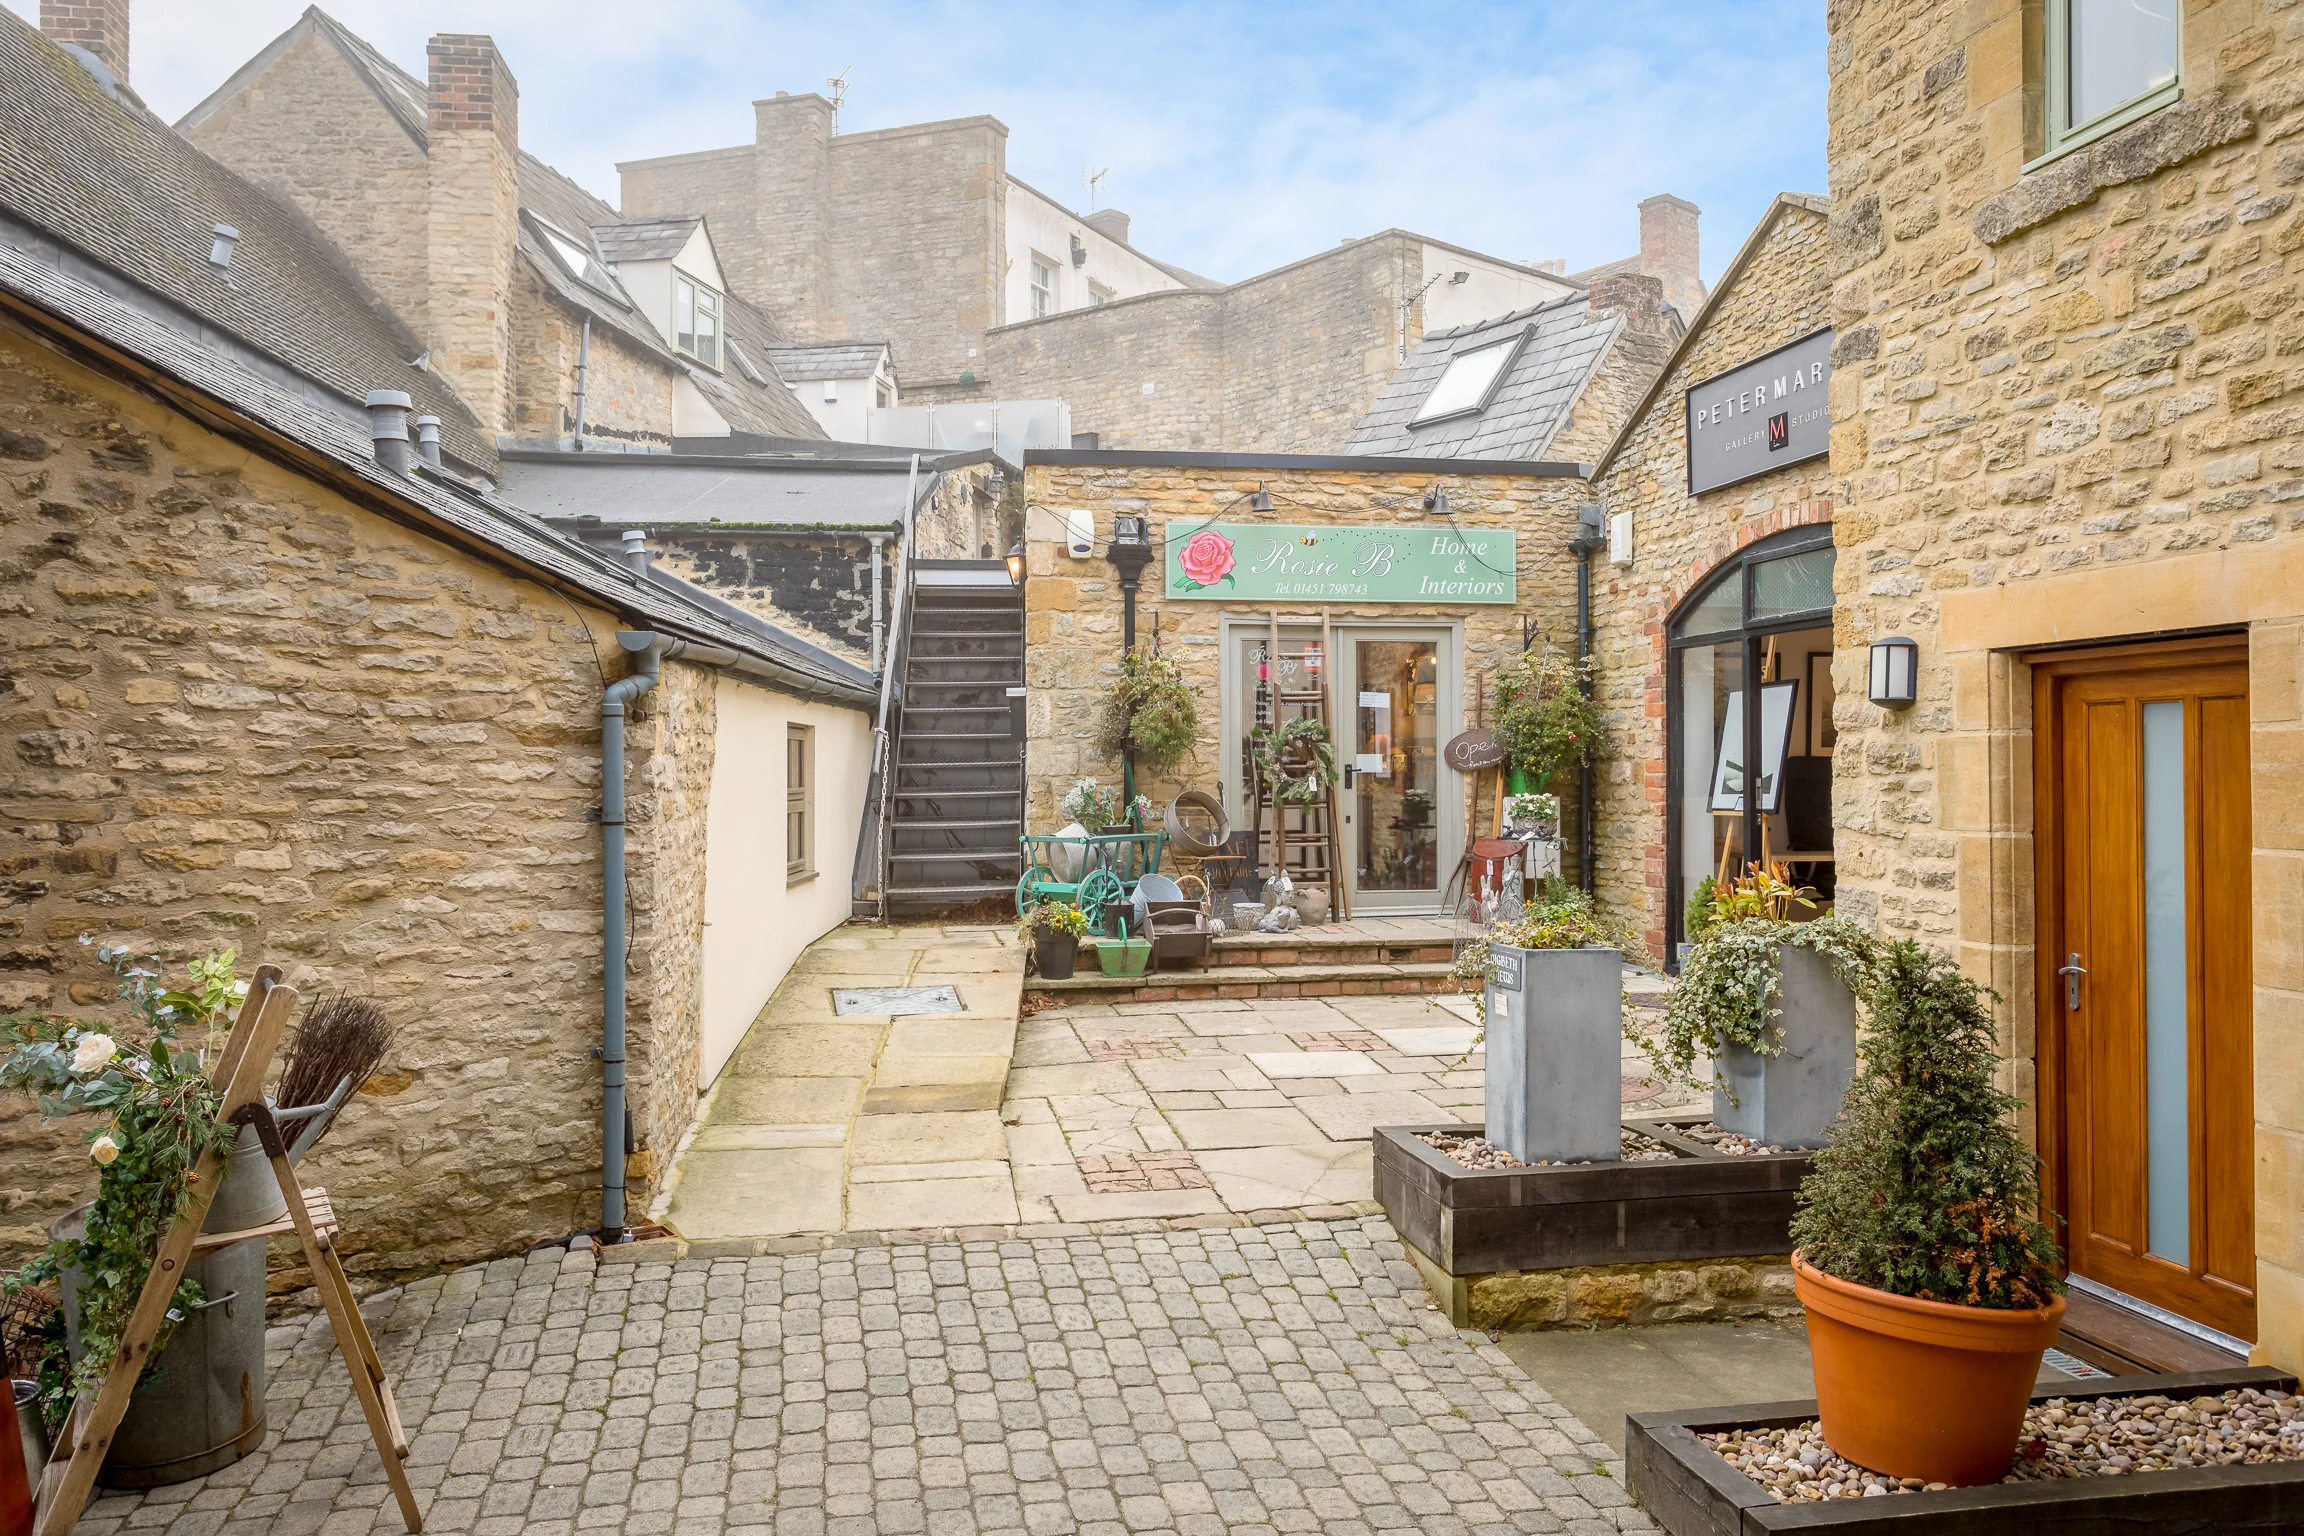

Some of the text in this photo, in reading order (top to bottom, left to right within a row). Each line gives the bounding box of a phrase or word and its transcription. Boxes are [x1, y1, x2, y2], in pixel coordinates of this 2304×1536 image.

[1698, 386, 1766, 429] PETER
[1725, 429, 1766, 452] GALLERY
[1769, 414, 1785, 442] M
[1429, 536, 1488, 556] Home
[1251, 538, 1396, 578] Rosie B
[1454, 559, 1468, 574] &
[1274, 582, 1368, 595] Tel. 01451 798743
[1418, 576, 1505, 595] Interiors
[1490, 953, 1518, 972] DIGBETH
